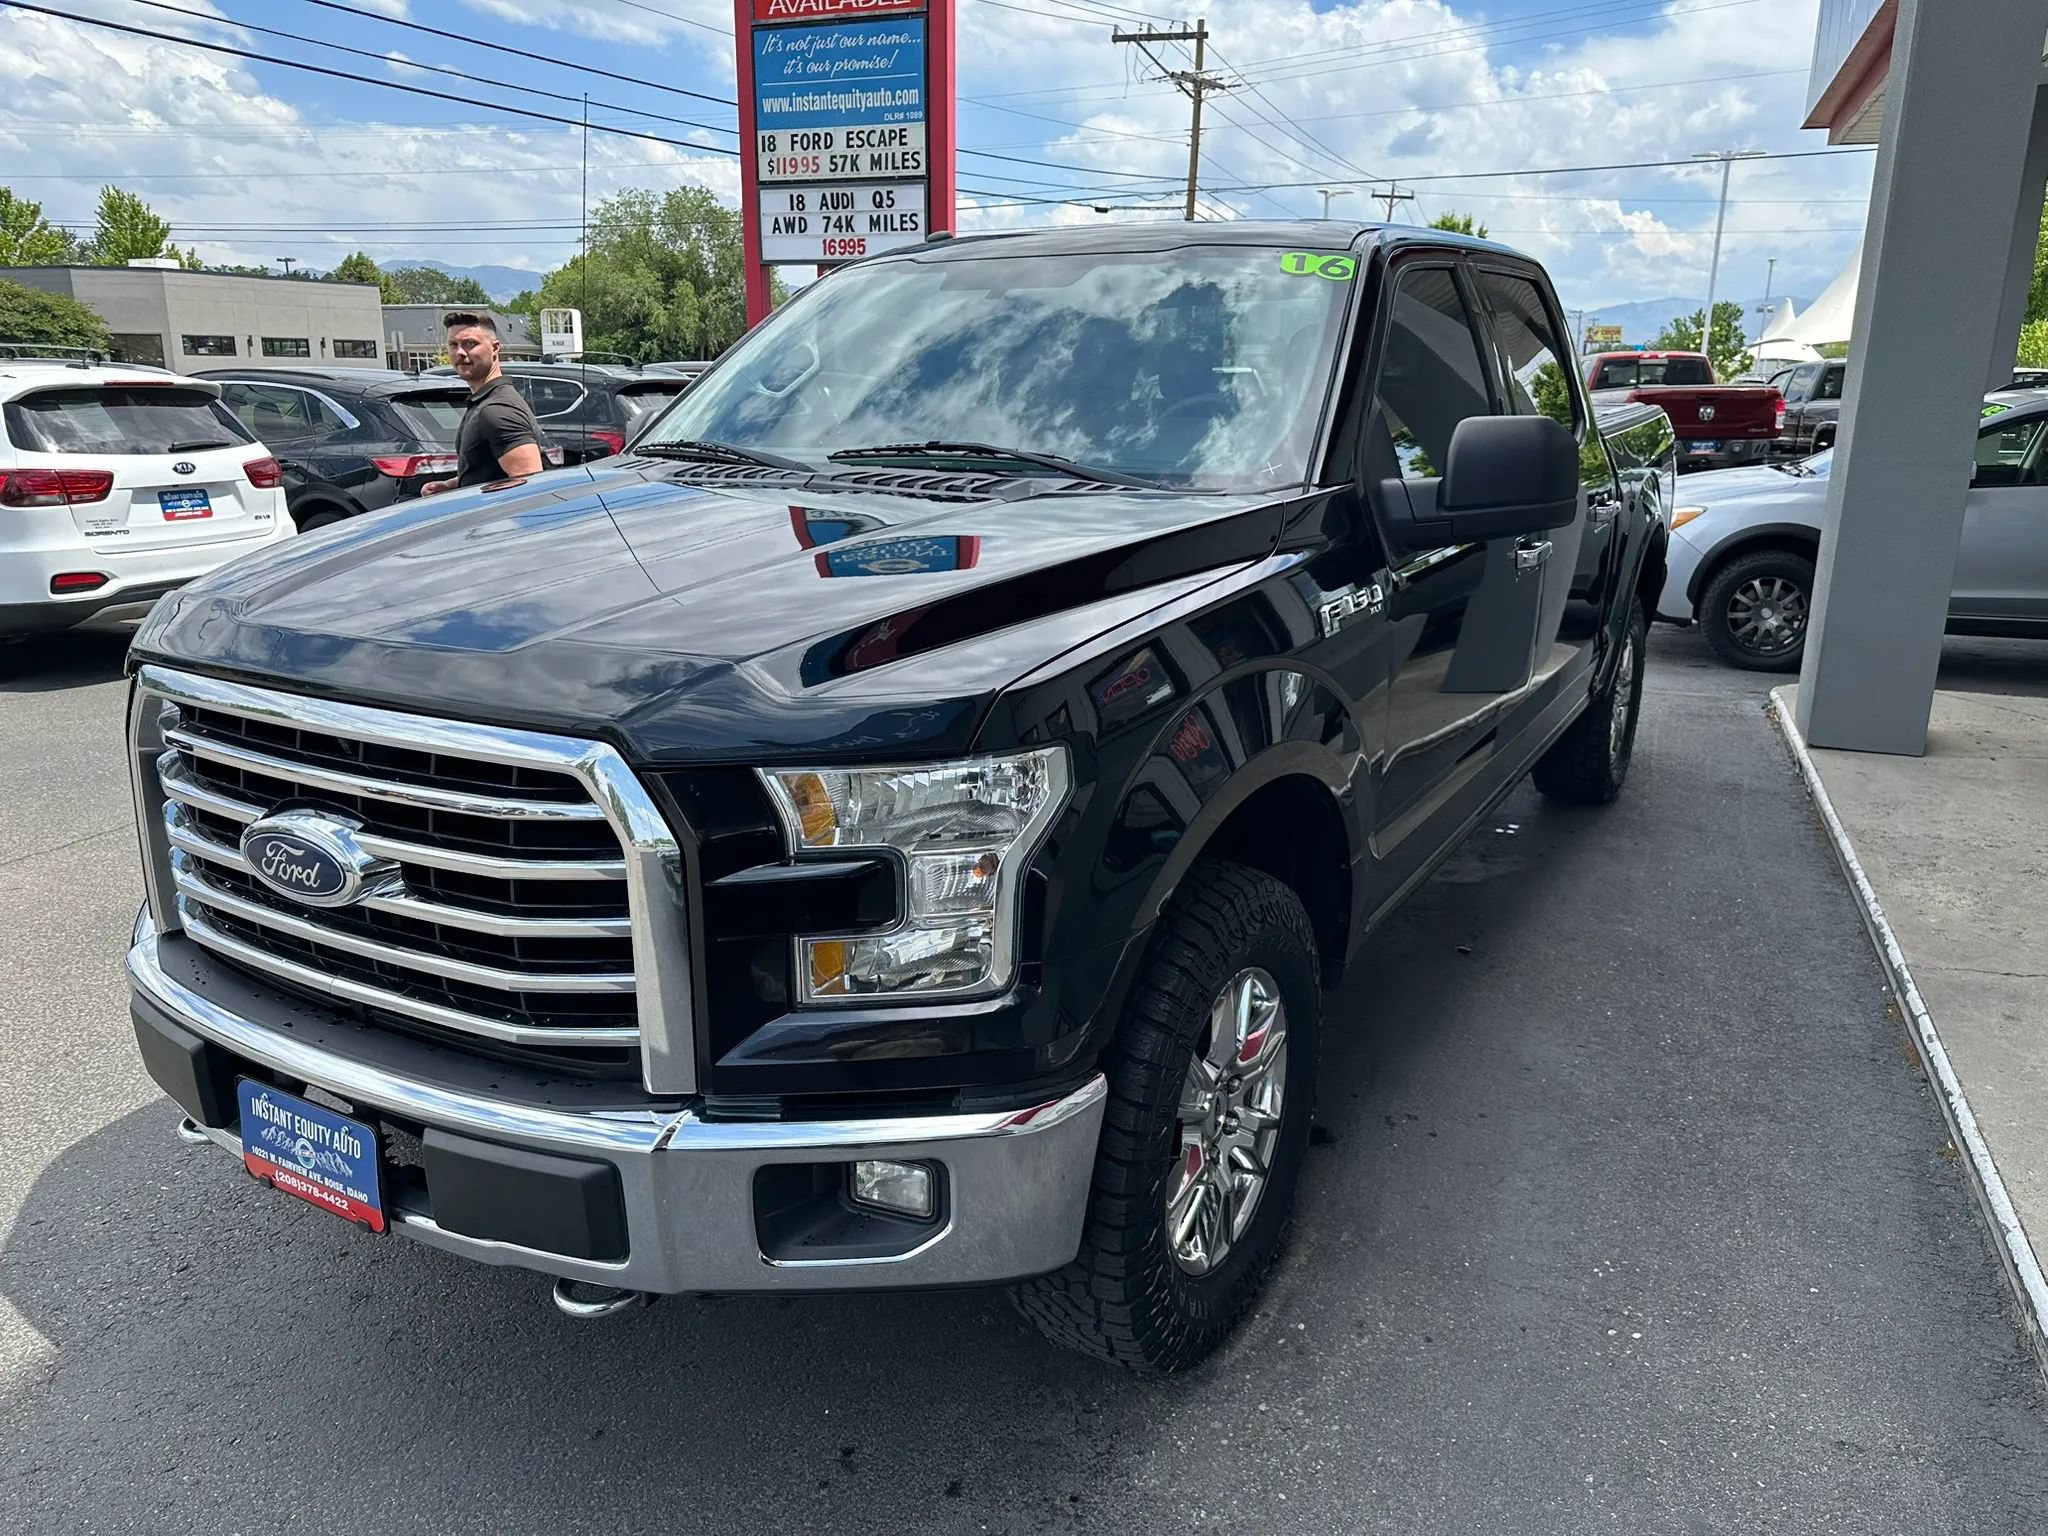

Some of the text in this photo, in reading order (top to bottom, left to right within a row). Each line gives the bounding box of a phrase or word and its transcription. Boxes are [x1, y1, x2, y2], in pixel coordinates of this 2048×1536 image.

[762, 32, 921, 58] It's not just our name...
[783, 49, 900, 78] it's our promise!
[762, 87, 919, 113] www.instantequityauto.com
[884, 112, 904, 121] DLR#
[761, 128, 908, 153] 18 FORD ESCAPE
[768, 151, 921, 175] $11995 57K MILES
[789, 190, 895, 212] 18 AUDI Q5
[772, 213, 919, 234] AWD 74K MILES
[822, 238, 866, 256] 16995
[1291, 254, 1351, 278] 16
[1369, 603, 1382, 615] XLT
[261, 841, 320, 888] Ford
[251, 1097, 361, 1159] INSTANT EQUITY AUTO
[251, 1145, 269, 1159] 10221
[269, 1152, 278, 1164] W.
[278, 1156, 308, 1177] FAIRVIEW
[347, 1189, 369, 1204] IDAHO
[274, 1169, 349, 1211] (208)378-4422
